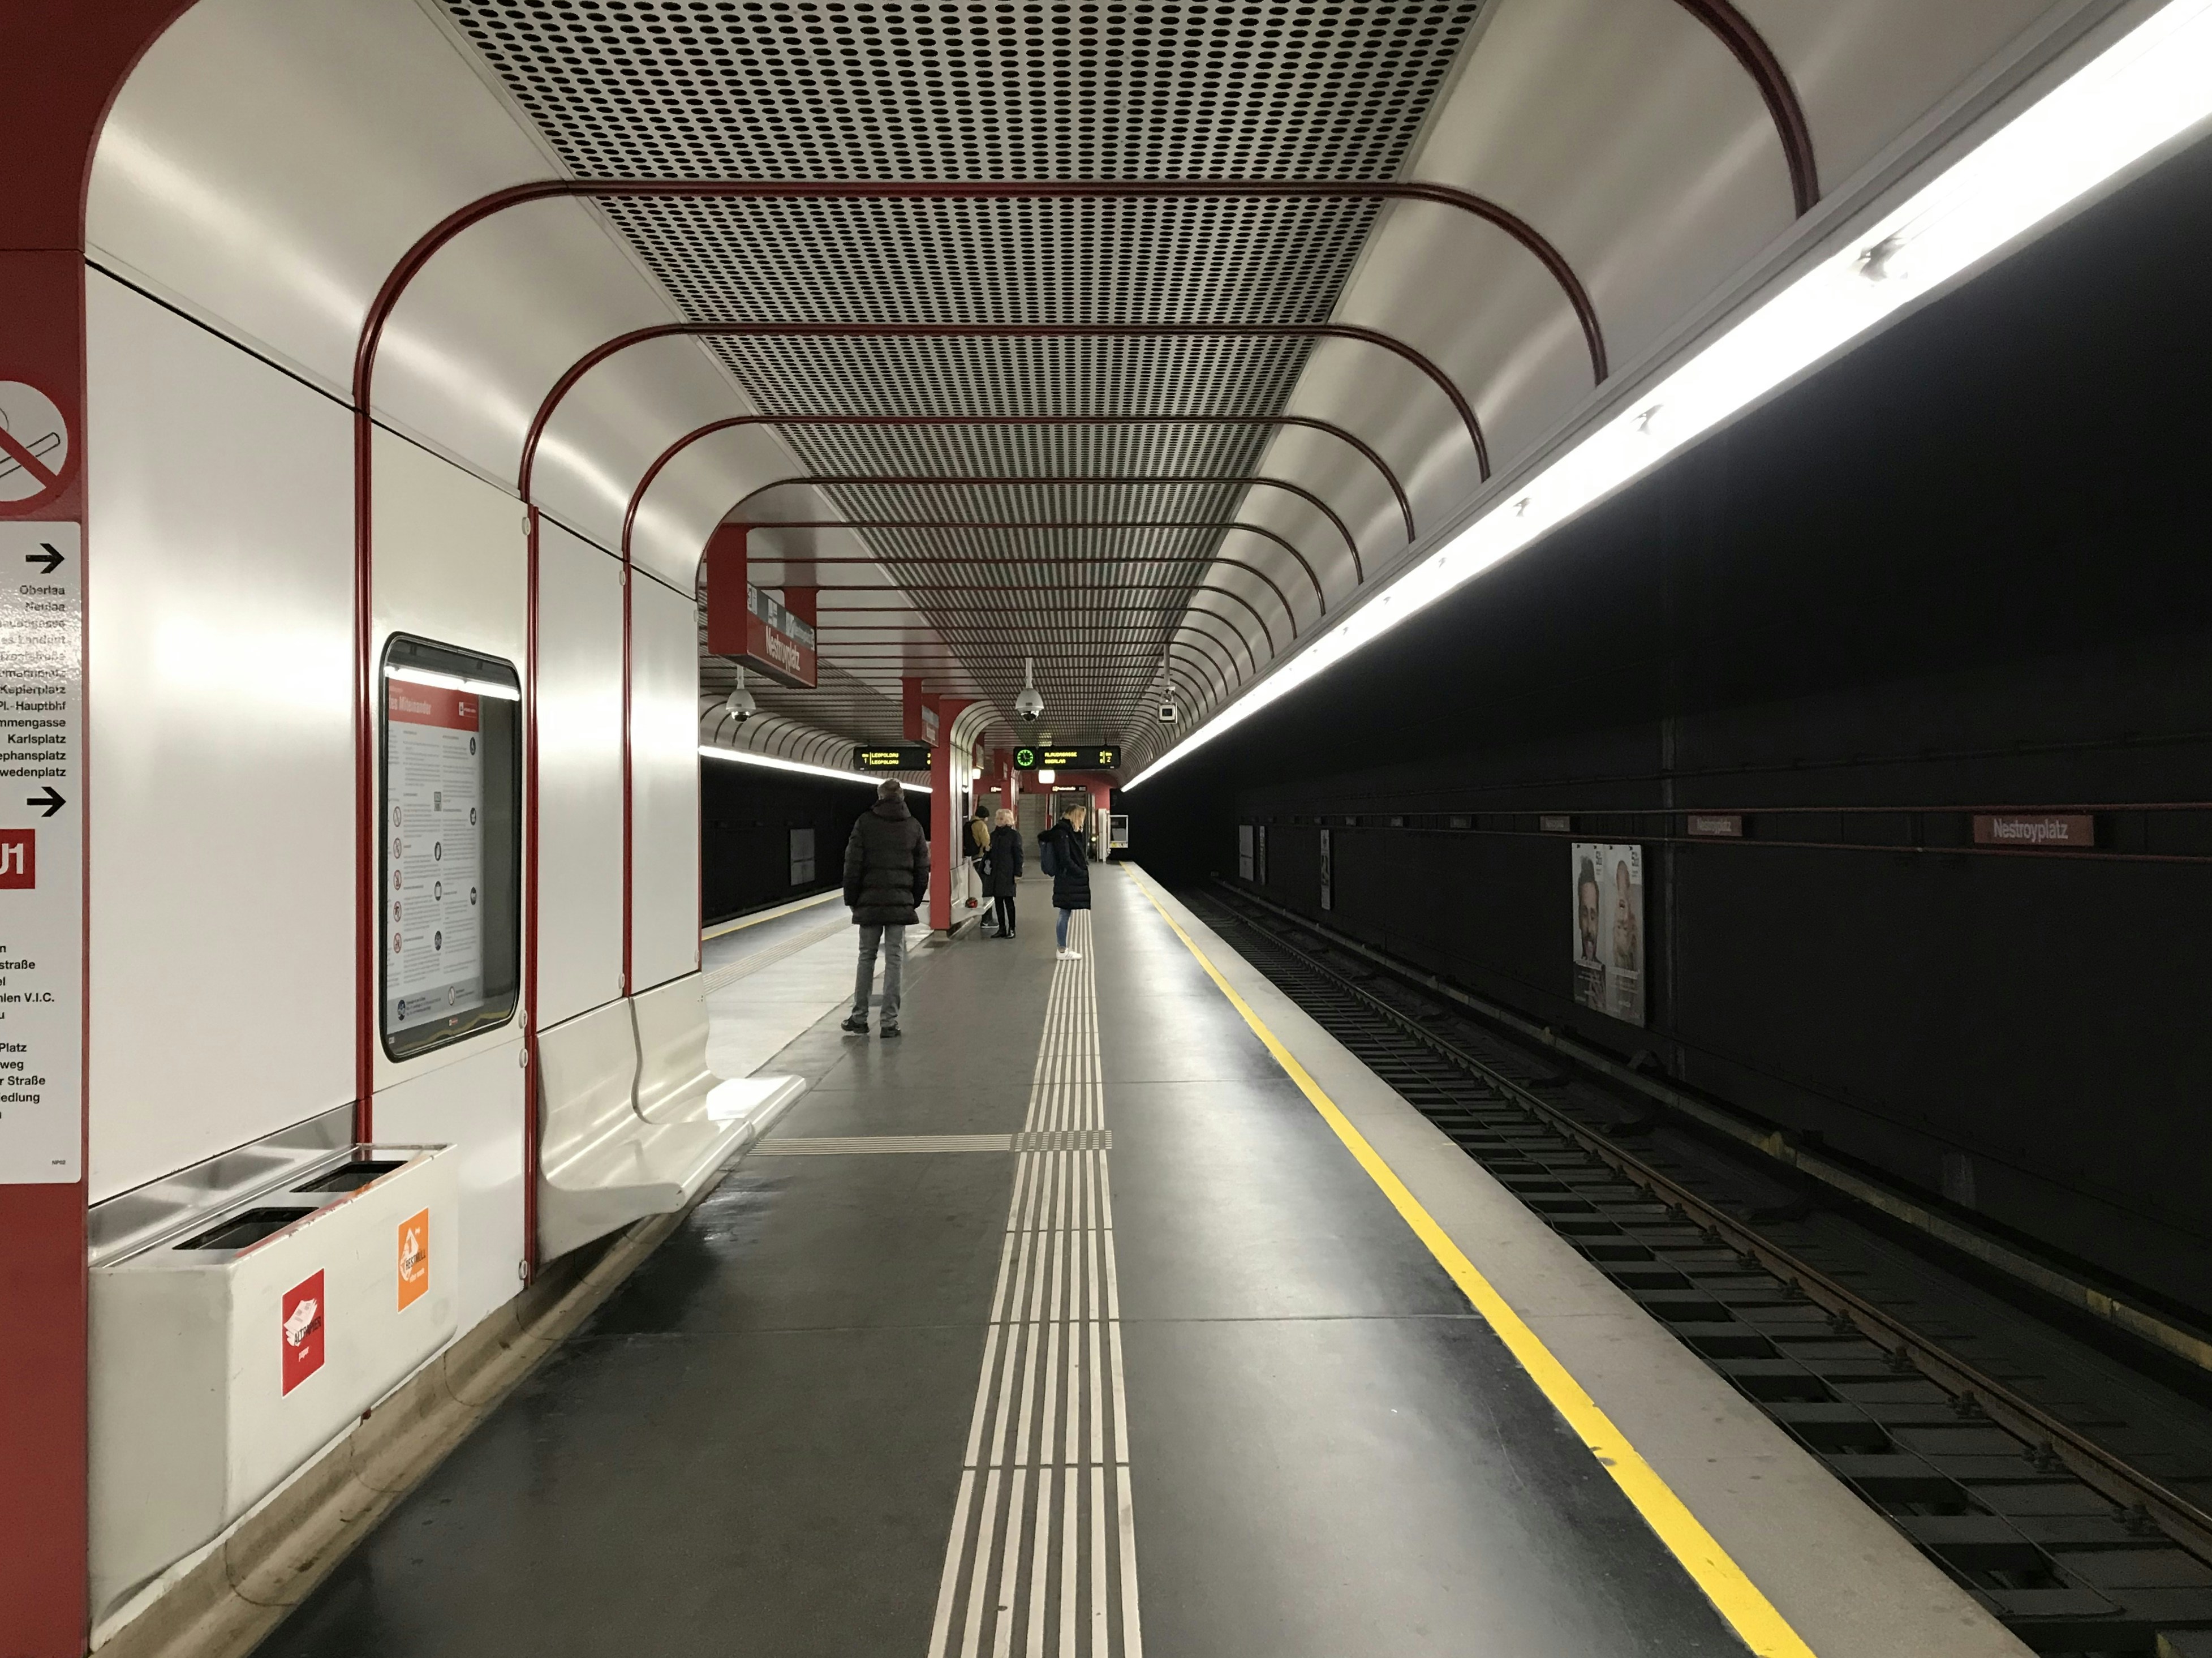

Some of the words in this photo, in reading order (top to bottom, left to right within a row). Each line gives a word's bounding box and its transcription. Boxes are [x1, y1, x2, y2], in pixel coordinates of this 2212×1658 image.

[20, 585, 65, 595] Oberlaa
[765, 625, 801, 672] Nestroyplatz
[7, 734, 66, 745] Karlsplatz
[1994, 818, 2068, 843] Nestroyplatz
[24, 993, 55, 1003] V.I.C.
[0, 1043, 27, 1053] Platz
[7, 1076, 46, 1085] Straße
[406, 1249, 426, 1270] RESTMÜLL
[294, 1316, 322, 1345] ALTPAPIER
